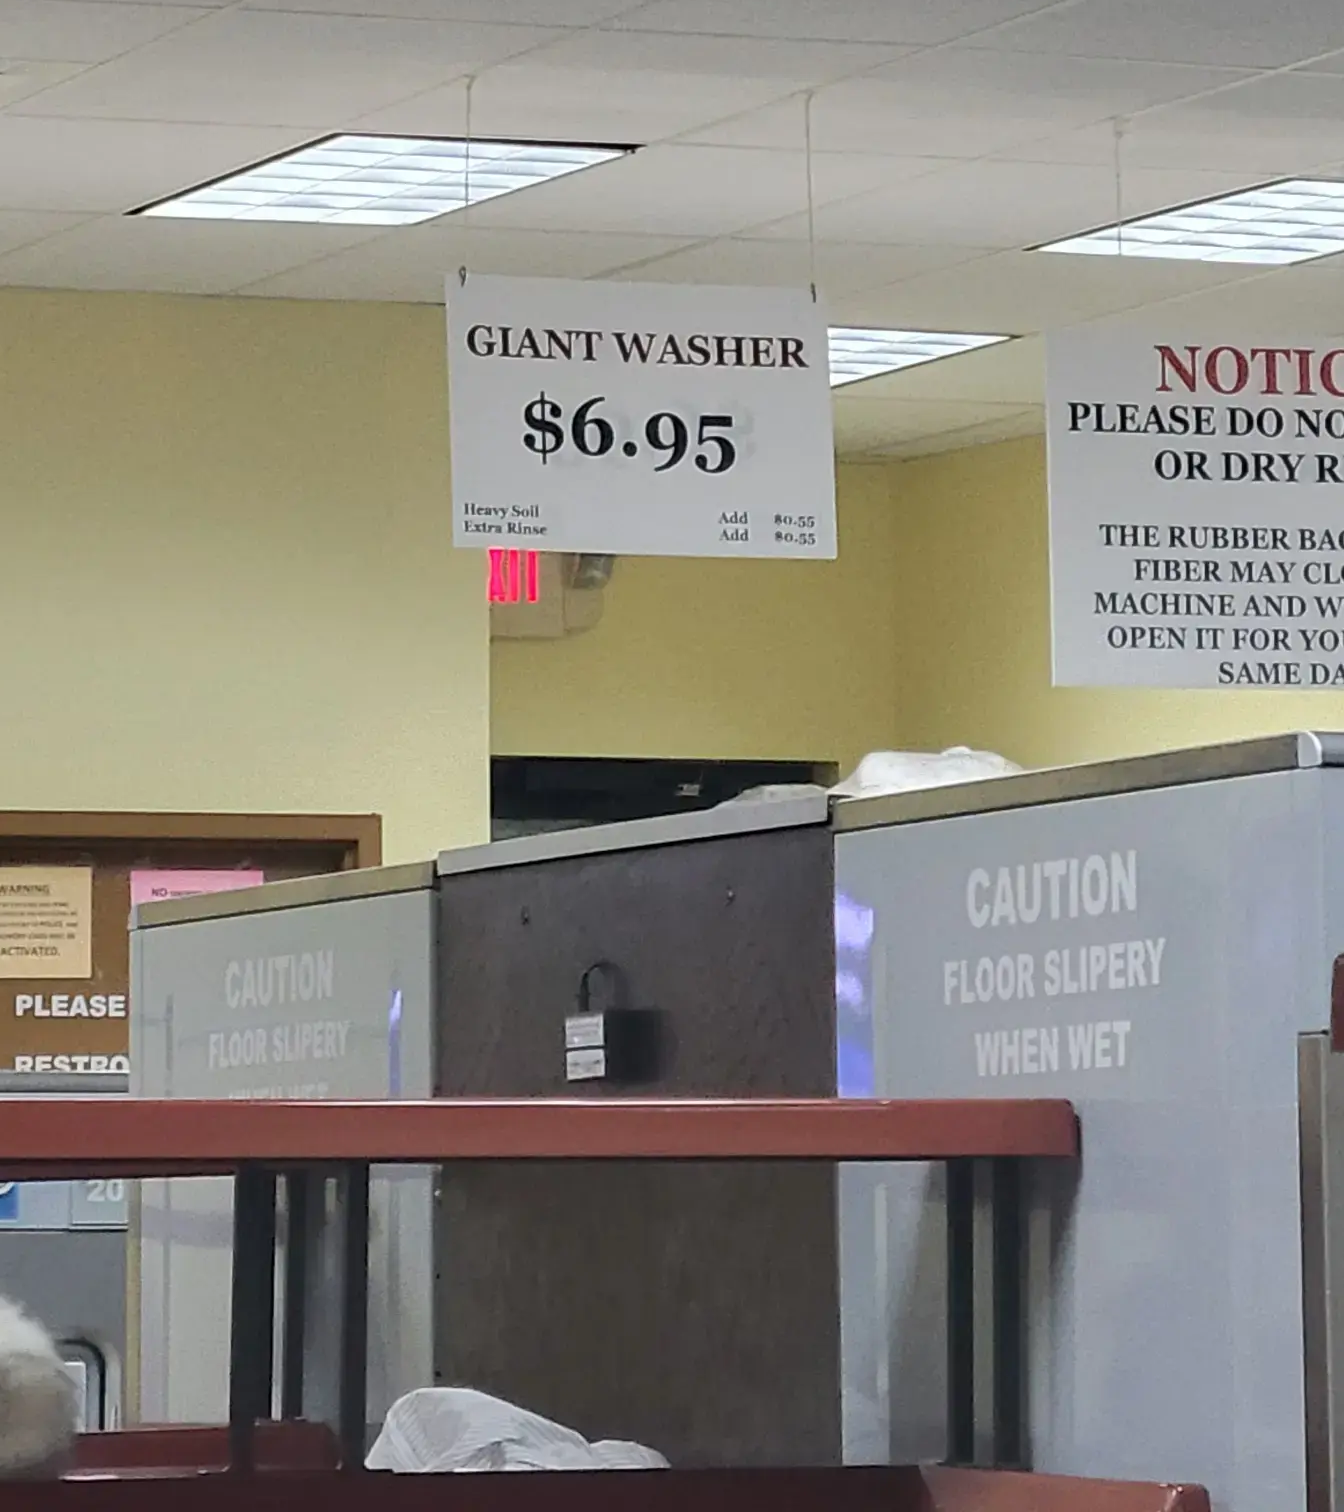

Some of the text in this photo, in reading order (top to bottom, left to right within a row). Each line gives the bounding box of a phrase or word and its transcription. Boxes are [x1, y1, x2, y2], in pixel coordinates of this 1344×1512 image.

[466, 324, 810, 368] GIANT WASHER
[523, 390, 736, 475] $6.95
[1068, 402, 1216, 437] PLEASE
[1227, 407, 1284, 438] DO
[1155, 449, 1211, 482] OR
[1222, 452, 1306, 483] DRY
[464, 502, 816, 529] Heavy Soil Add $0.55
[464, 520, 817, 546] Extra Rinse Add $0.55
[1099, 524, 1159, 549] THE
[1168, 525, 1288, 551] RUBBER
[1134, 559, 1221, 584] FIBER
[1230, 561, 1297, 585] MAY
[1094, 592, 1235, 618] MACHINE
[1242, 595, 1306, 619] AND
[1107, 626, 1187, 651] OPEN
[1194, 628, 1225, 650] IT
[1232, 628, 1292, 652] FOR
[1218, 661, 1302, 686] SAME
[967, 849, 1137, 928] CAUTION
[225, 949, 334, 1009] CAUTION
[944, 937, 1167, 1005] FLOOR SLIPERY
[15, 994, 126, 1017] PLEASE
[209, 1020, 351, 1069] FLOOR SLIPERY
[975, 1020, 1131, 1076] WHEN WET
